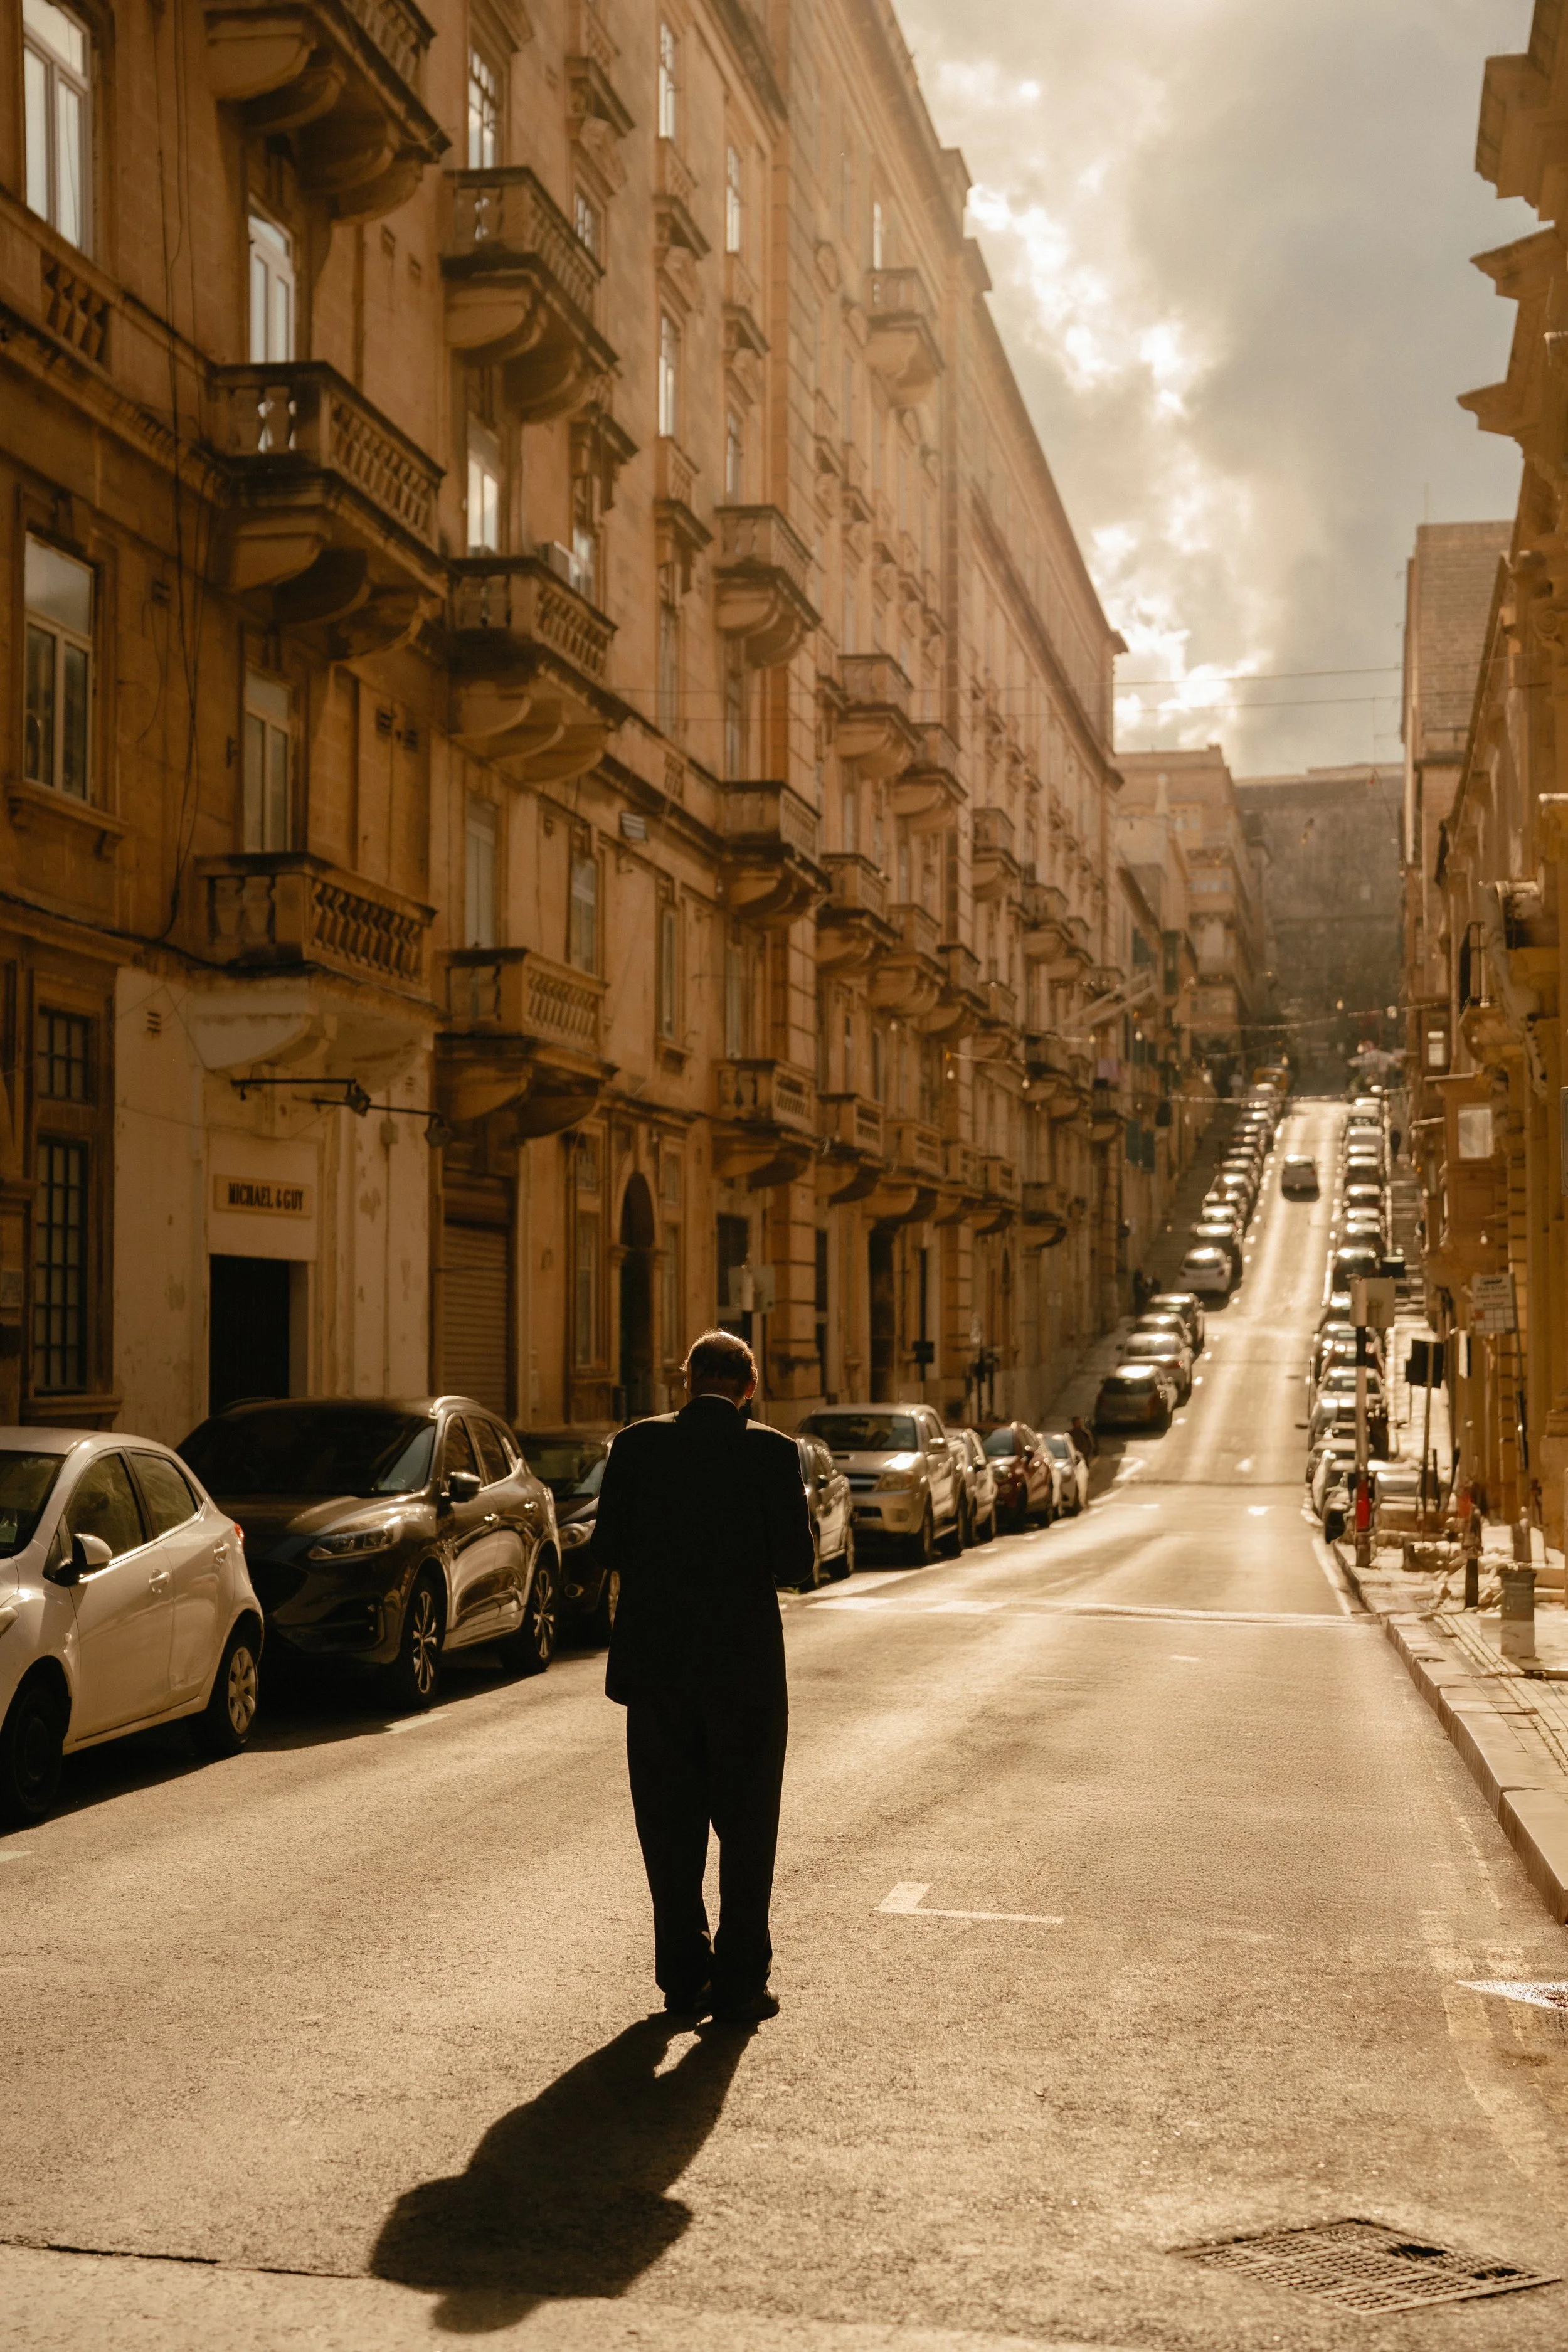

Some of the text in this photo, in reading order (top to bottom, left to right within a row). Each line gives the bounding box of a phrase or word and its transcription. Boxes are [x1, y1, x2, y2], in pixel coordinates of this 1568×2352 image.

[228, 1182, 303, 1210] MICHAEL & GUY
